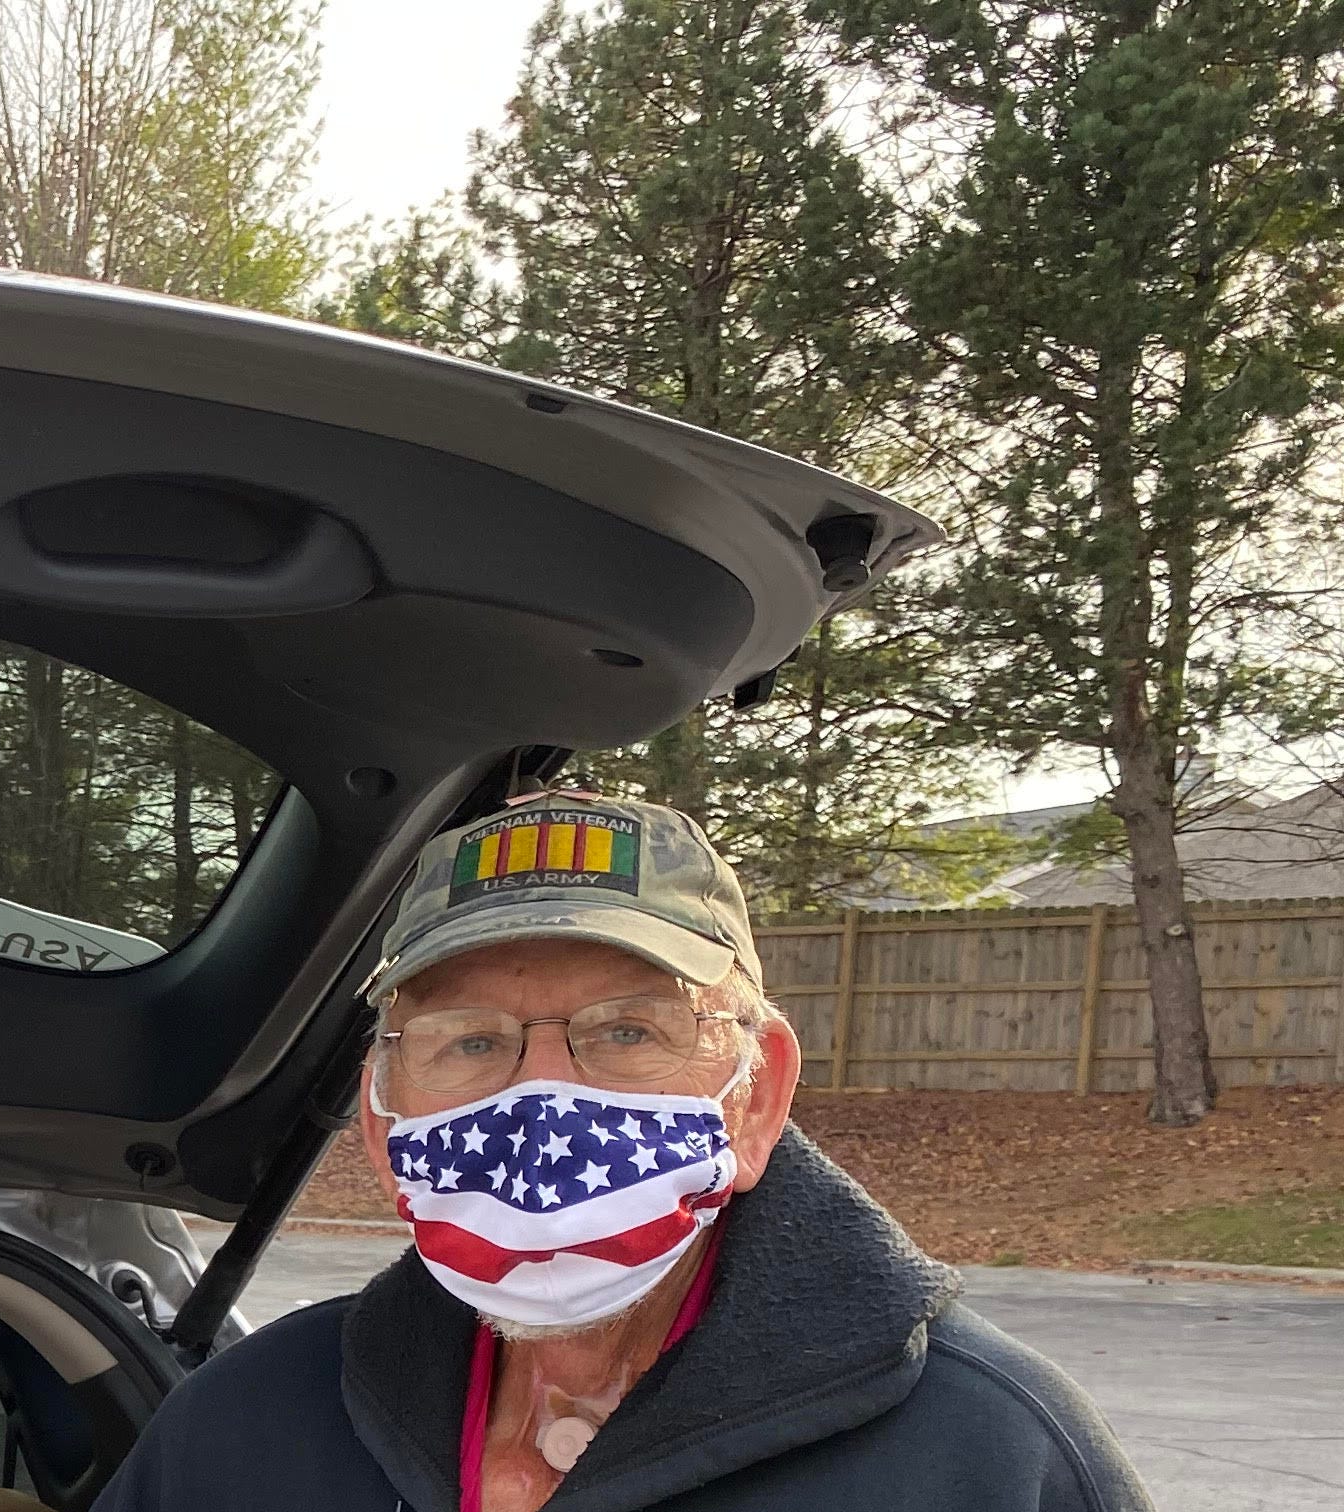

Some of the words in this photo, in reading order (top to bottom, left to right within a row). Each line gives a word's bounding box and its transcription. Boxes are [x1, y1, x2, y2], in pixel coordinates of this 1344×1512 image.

[466, 813, 542, 844] VIETNAM
[550, 811, 633, 834] VETERAN
[525, 873, 600, 885] ARMY
